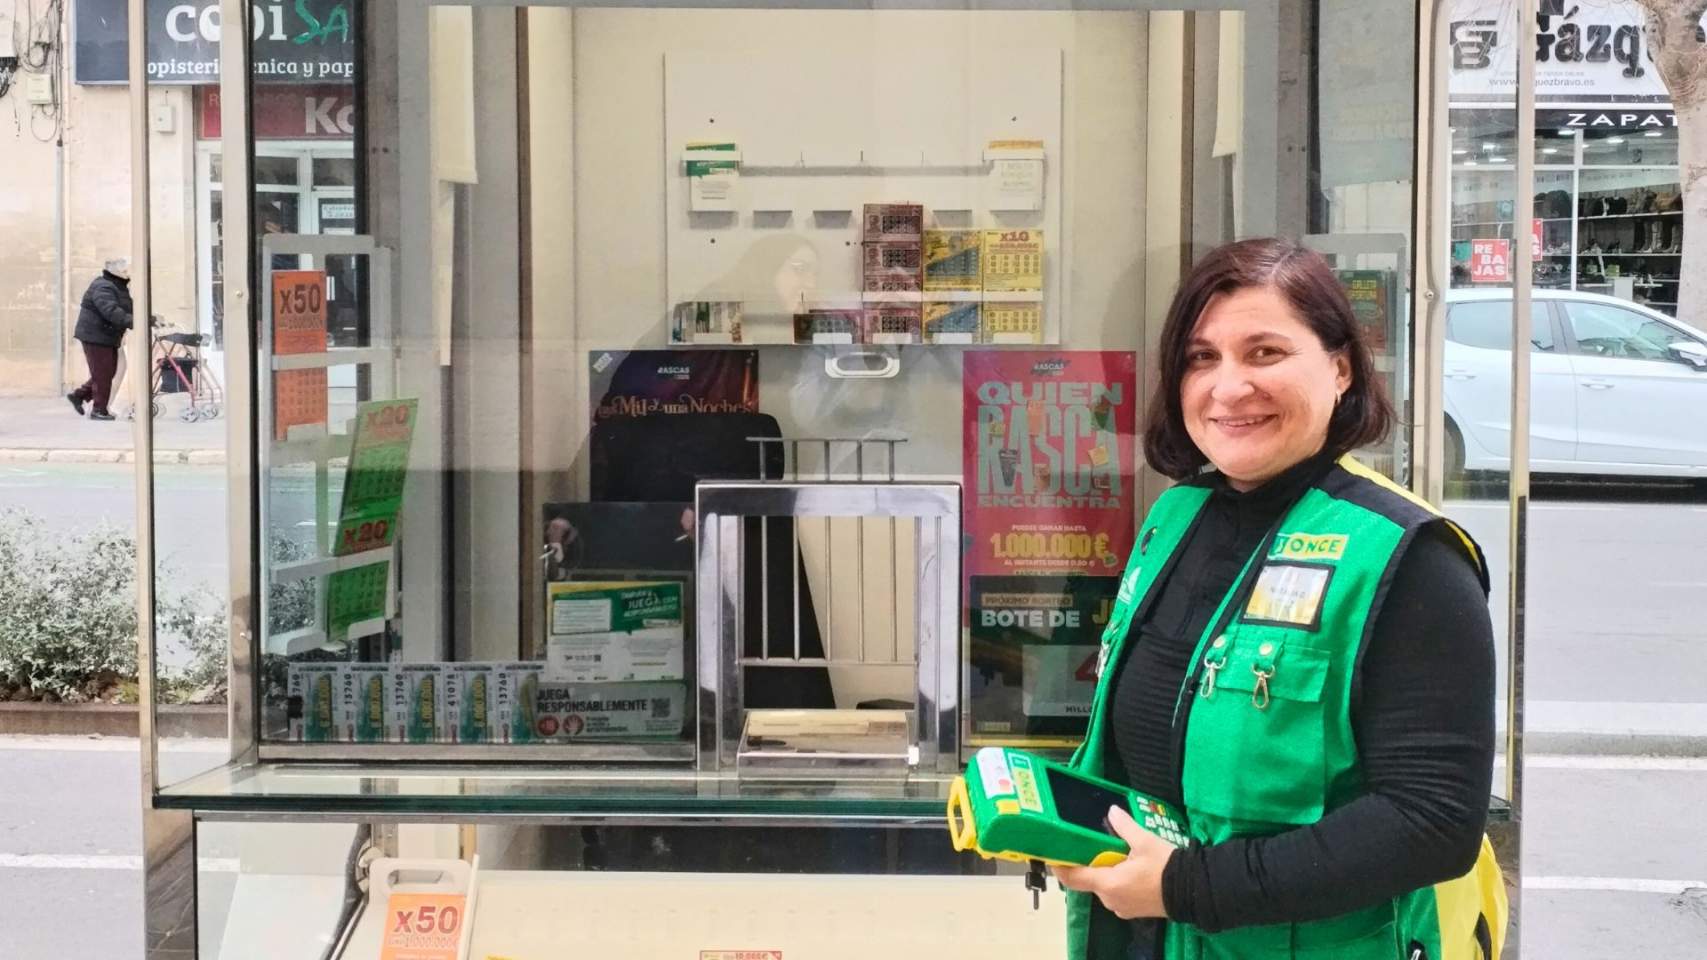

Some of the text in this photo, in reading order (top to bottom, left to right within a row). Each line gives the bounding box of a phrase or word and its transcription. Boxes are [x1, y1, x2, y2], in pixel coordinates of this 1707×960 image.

[147, 58, 219, 78] opisteri
[302, 62, 313, 78] y
[318, 61, 354, 78] pap
[1566, 113, 1678, 127] ZAPAT
[1473, 244, 1493, 255] RE
[1481, 254, 1503, 266] BA
[1473, 265, 1505, 276] JAS
[279, 283, 321, 315] x50
[977, 381, 1124, 405] QUIEN
[977, 404, 1123, 496] RASCA
[978, 495, 1122, 509] ENCUENTRA
[1290, 538, 1342, 553] ONCE
[981, 609, 1081, 628] BOTE DE
[536, 689, 571, 701] JUEGA
[536, 698, 648, 714] RESPONSABLEMENTE
[394, 905, 459, 934] x50
